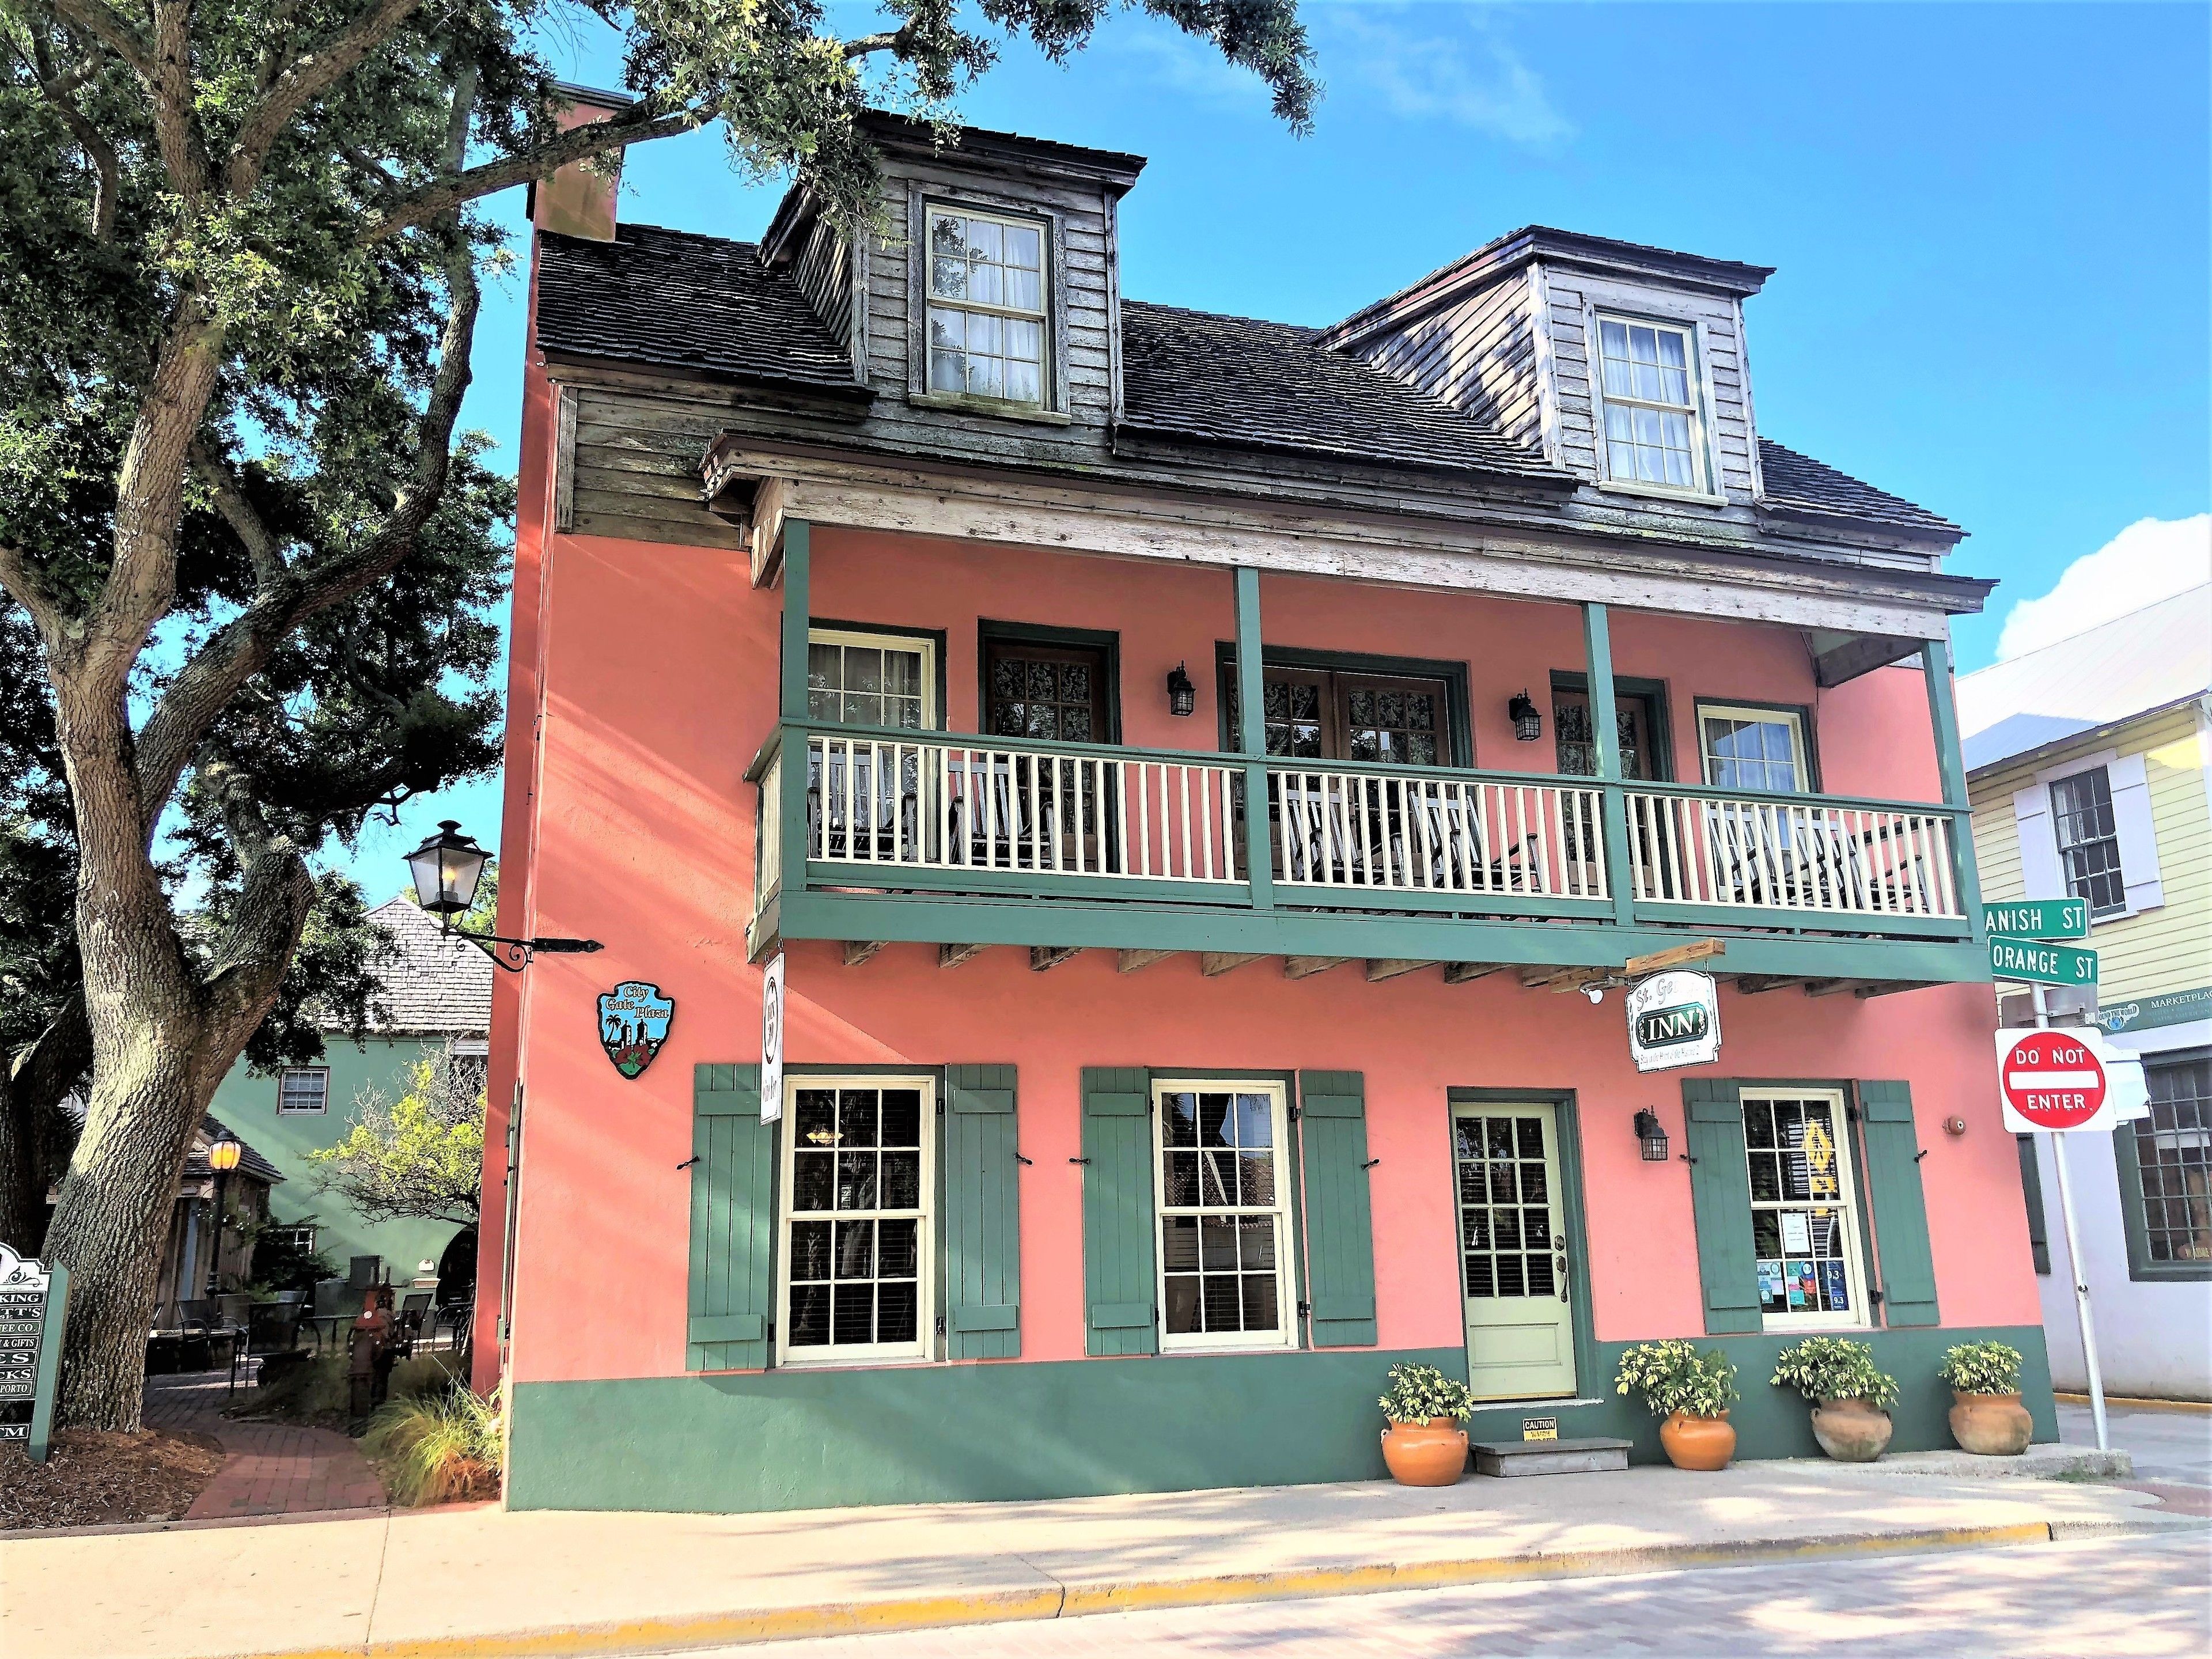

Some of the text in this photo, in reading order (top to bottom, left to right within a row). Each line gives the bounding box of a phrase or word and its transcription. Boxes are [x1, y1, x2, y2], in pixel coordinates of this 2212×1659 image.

[1985, 906, 2083, 931] ANISH ST
[1993, 945, 2093, 979] ORANGE ST
[623, 986, 649, 1002] City
[1636, 988, 1652, 1011] St.
[605, 998, 635, 1011] Gate
[634, 1005, 669, 1018] Plaza
[1648, 1010, 1695, 1041] INN
[2016, 1048, 2085, 1065] DO NOT
[2027, 1093, 2086, 1110] ENTER
[0, 1294, 39, 1303] KING
[0, 1323, 36, 1332] EE CO.
[3, 1339, 10, 1347] &
[12, 1339, 35, 1347] GIFTS
[0, 1384, 28, 1393] PORTO
[1525, 1420, 1554, 1429] CAUTION
